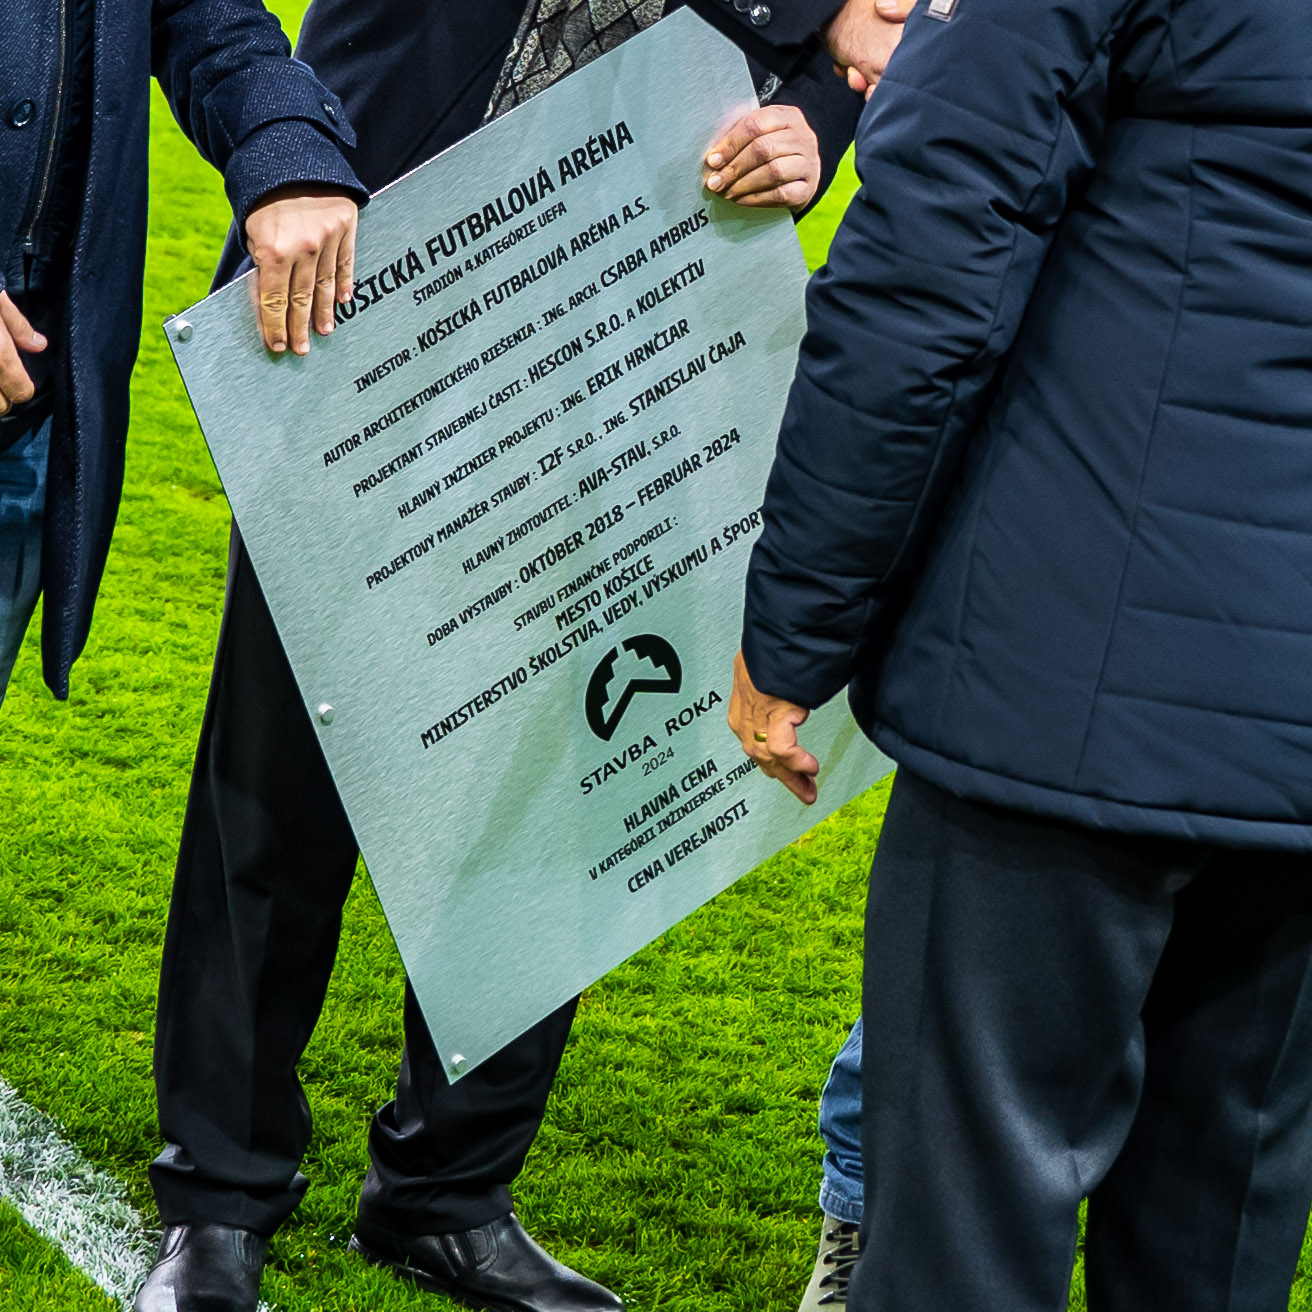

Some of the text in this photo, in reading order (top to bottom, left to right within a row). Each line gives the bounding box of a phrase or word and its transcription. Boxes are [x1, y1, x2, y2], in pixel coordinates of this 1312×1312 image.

[413, 201, 567, 306] ŠTADIÓN 4.KATEGÓRIE UEFA
[425, 166, 555, 266] FUTBALOVÁ
[558, 121, 634, 186] ARÉNA
[323, 433, 362, 467] AUTOR
[363, 358, 479, 441] ARCHITEKTONICKÉHO
[480, 322, 536, 365] RIEŠENIA
[541, 303, 568, 326] ING.
[568, 282, 601, 310] ARCH.
[600, 248, 648, 287] CSABA
[649, 208, 708, 258] AMBRUS
[353, 349, 412, 393] INVESTOR
[416, 298, 483, 352] KOŠICKÁ
[482, 244, 569, 310] FUTBALOVÁ
[570, 213, 620, 256] ARÉNA
[622, 196, 649, 224] A.S.
[353, 442, 423, 497] PROJEKTANT
[425, 401, 487, 451] STAVEBNEJ
[488, 379, 523, 409] ČASTI
[527, 336, 583, 384] HESCON
[584, 314, 624, 348] S.R.O.
[626, 308, 636, 322] A
[636, 258, 704, 314] KOLEKTÍV
[397, 480, 441, 519] HLAVNÝ
[441, 446, 498, 490] INŽINIER
[498, 408, 554, 454] PROJEKTU
[560, 389, 586, 413] ING.
[586, 360, 624, 396] ERIK
[624, 319, 690, 371] HRNČIAR
[366, 533, 435, 589] PROJEKTOVÝ
[436, 500, 490, 543] MANAŽÉR
[490, 472, 530, 508] STAVBY
[537, 446, 563, 476] I2F
[567, 432, 597, 458] S.R.O.
[602, 411, 628, 434] ING.
[628, 354, 706, 416] STANISLAV
[708, 331, 746, 364] ČAJA
[462, 536, 504, 574] HLAVNÝ
[578, 440, 651, 498] AVA-STAV,
[651, 424, 681, 450] S.R.O.
[426, 618, 459, 646] DOBA
[458, 580, 512, 624] VÝSTAVBY
[519, 531, 585, 583] OKTÓBER
[584, 505, 624, 540] 2018
[637, 453, 703, 506] FEBRUÁR
[702, 428, 740, 463] 2024
[513, 594, 555, 631] STAVBU
[556, 557, 612, 602] FINANČNE
[612, 517, 673, 565] PODPORILI
[555, 554, 654, 631] MESTO KOŠICE
[420, 666, 527, 749] MINISTERSTVO
[529, 619, 603, 676] ŠKOLSTVA,
[602, 590, 643, 625] VEDY,
[641, 544, 707, 599] VÝSKUMU
[710, 537, 722, 555] A
[580, 690, 722, 795] STAVBA ROKA
[623, 759, 718, 833] HLAVNÁ CENA
[642, 746, 674, 776] 2024
[588, 867, 597, 880] V
[598, 826, 657, 874] KATEGÓRII
[655, 778, 726, 834] INŽINIERSKE
[628, 798, 749, 893] CENA VEREJNOSTI
